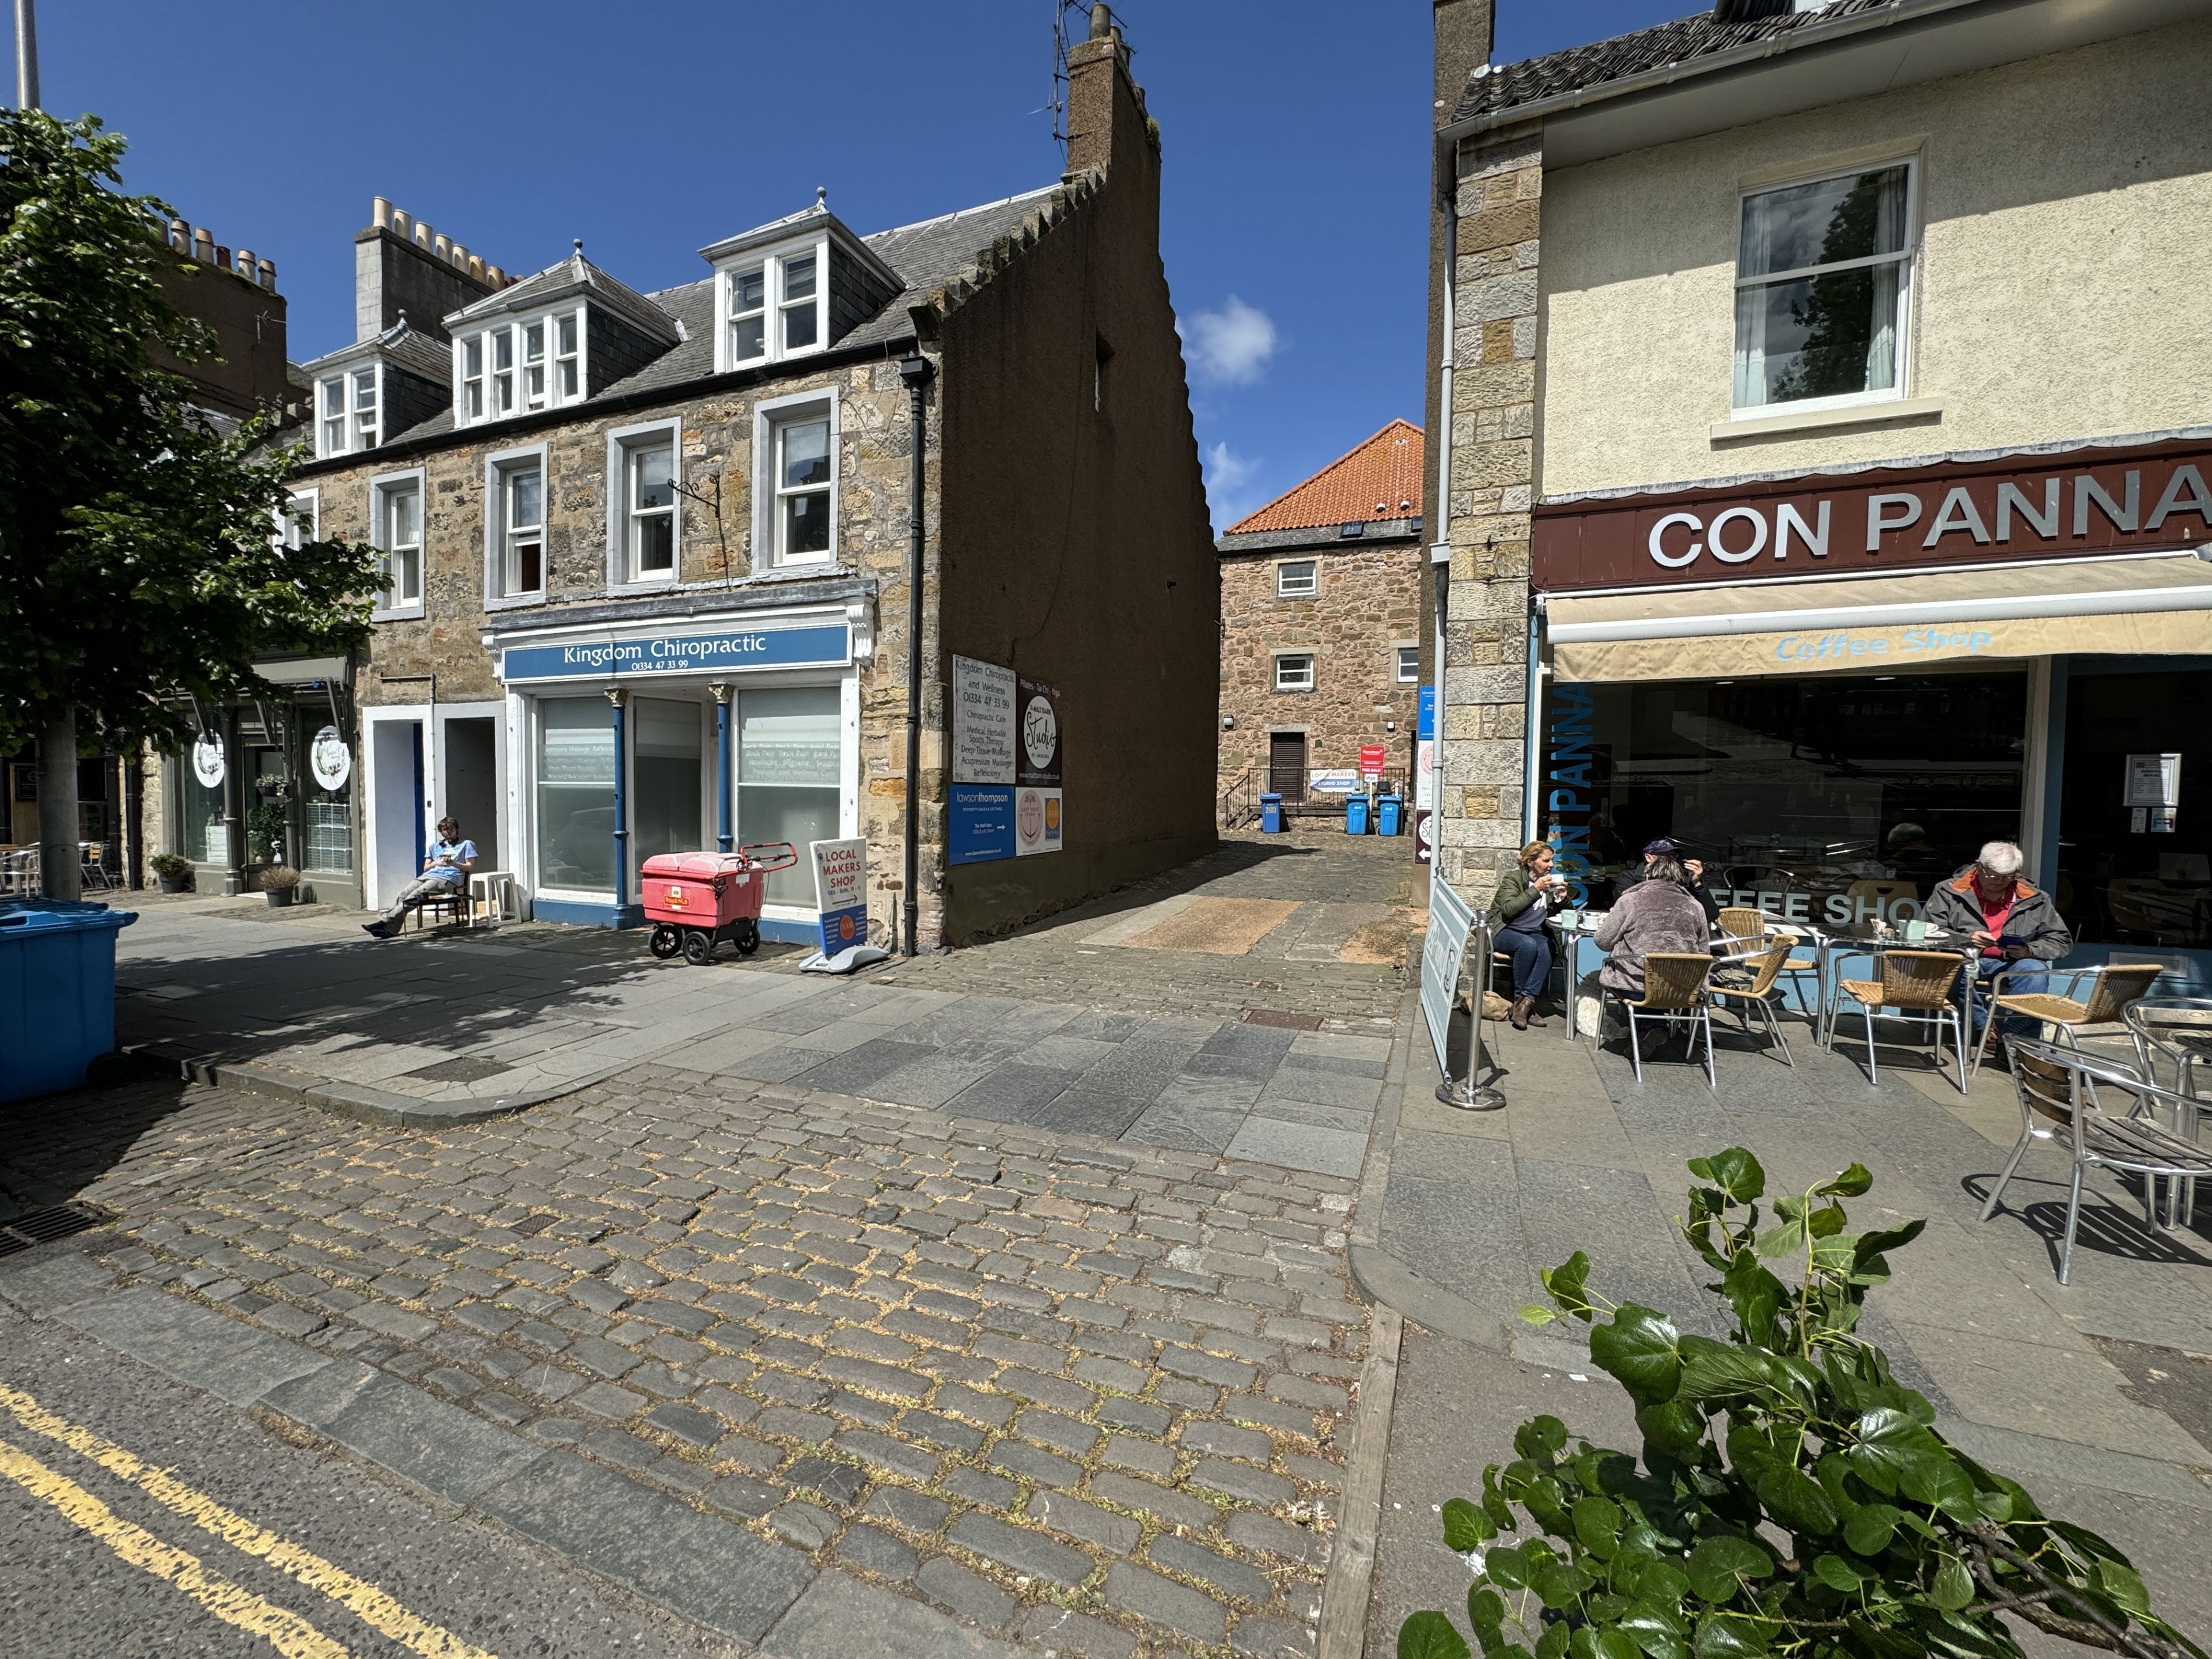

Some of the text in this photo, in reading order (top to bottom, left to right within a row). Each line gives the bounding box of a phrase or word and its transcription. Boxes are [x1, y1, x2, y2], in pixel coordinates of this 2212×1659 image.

[1649, 464, 2212, 568] CON PANNA
[564, 634, 767, 666] Kingdom Chiropractic
[1776, 629, 1991, 661] Coffee Shop
[631, 660, 688, 671] 01334 47 33 99
[956, 659, 1015, 683] Kingdom Chiropractic
[968, 681, 1005, 695] and Wellness
[1020, 679, 1034, 690] Pilates
[1052, 688, 1060, 699] Yoga
[963, 691, 1010, 710] 01334 47 33 99
[967, 710, 1006, 724] Chiropractic Care
[1033, 706, 1041, 714] MALT
[967, 725, 1006, 737] Medical Herbalist
[969, 734, 1004, 747] Sports Therapy
[1550, 682, 1594, 812] PANNA
[991, 747, 1012, 759] Massage
[961, 756, 1012, 769] Acupressure Massage
[974, 768, 1001, 779] Reflexology
[957, 791, 1008, 805] lawsonthompson
[825, 849, 857, 862] LOCAL
[823, 862, 861, 876] MAKERS
[831, 875, 855, 888] SHOP
[665, 896, 678, 904] Royal
[1709, 889, 1923, 929] FFEE SHO
